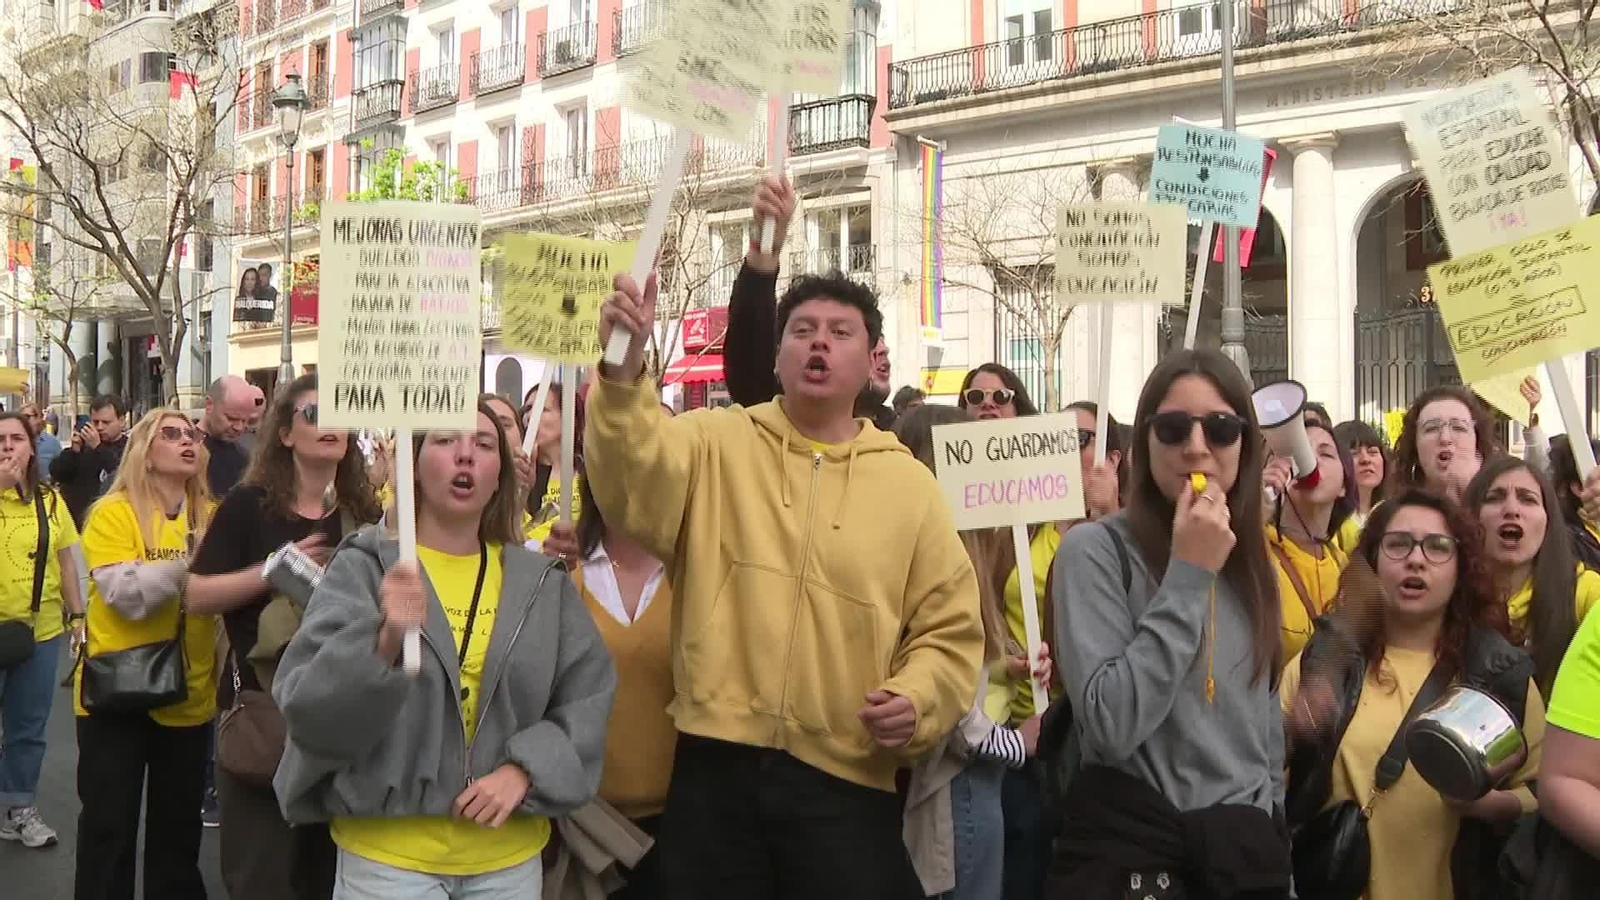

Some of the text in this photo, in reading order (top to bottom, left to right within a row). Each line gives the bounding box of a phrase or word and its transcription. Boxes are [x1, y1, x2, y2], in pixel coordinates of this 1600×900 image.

[1265, 79, 1387, 108] MINISTERIO
[1185, 129, 1238, 152] MUCHA
[1438, 107, 1531, 150] ESTATAL
[1484, 125, 1549, 161] EDUCAR
[1447, 150, 1553, 198] CON CALIDAD
[1155, 179, 1249, 204] CONDICIONES
[1448, 191, 1503, 223] BAJADA
[1503, 184, 1526, 206] DE
[333, 216, 479, 249] MEJORAS URGENTES
[1065, 209, 1086, 228] NO
[1078, 250, 1141, 268] SOMOS
[334, 383, 387, 414] PARA
[944, 428, 1078, 466] NO GUARDAMOS
[964, 473, 1069, 510] EDUCAMOS
